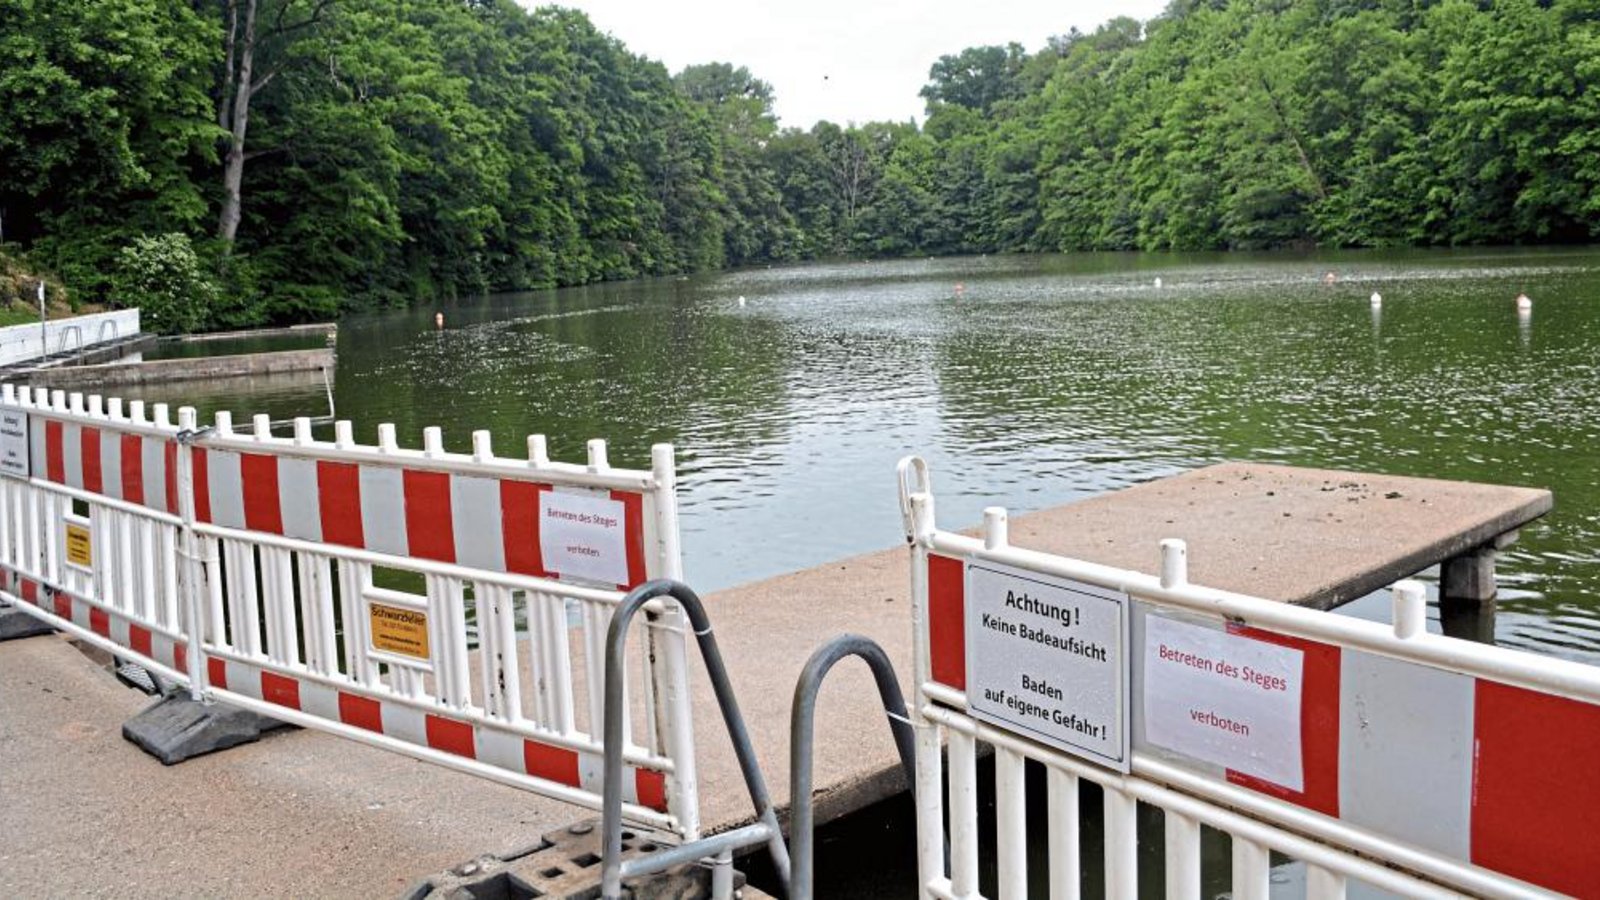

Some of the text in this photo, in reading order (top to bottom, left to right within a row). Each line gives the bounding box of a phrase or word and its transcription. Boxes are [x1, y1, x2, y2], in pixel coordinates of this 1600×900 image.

[547, 507, 617, 528] Betreten des Steges
[566, 545, 600, 557] verboten
[982, 613, 1107, 662] Keine Badeaufsicht
[1159, 644, 1288, 691] Betreten des Steges
[1022, 674, 1063, 701] Baden
[984, 688, 1005, 704] auf
[1007, 696, 1050, 720] eigene
[1189, 709, 1250, 737] verboten
